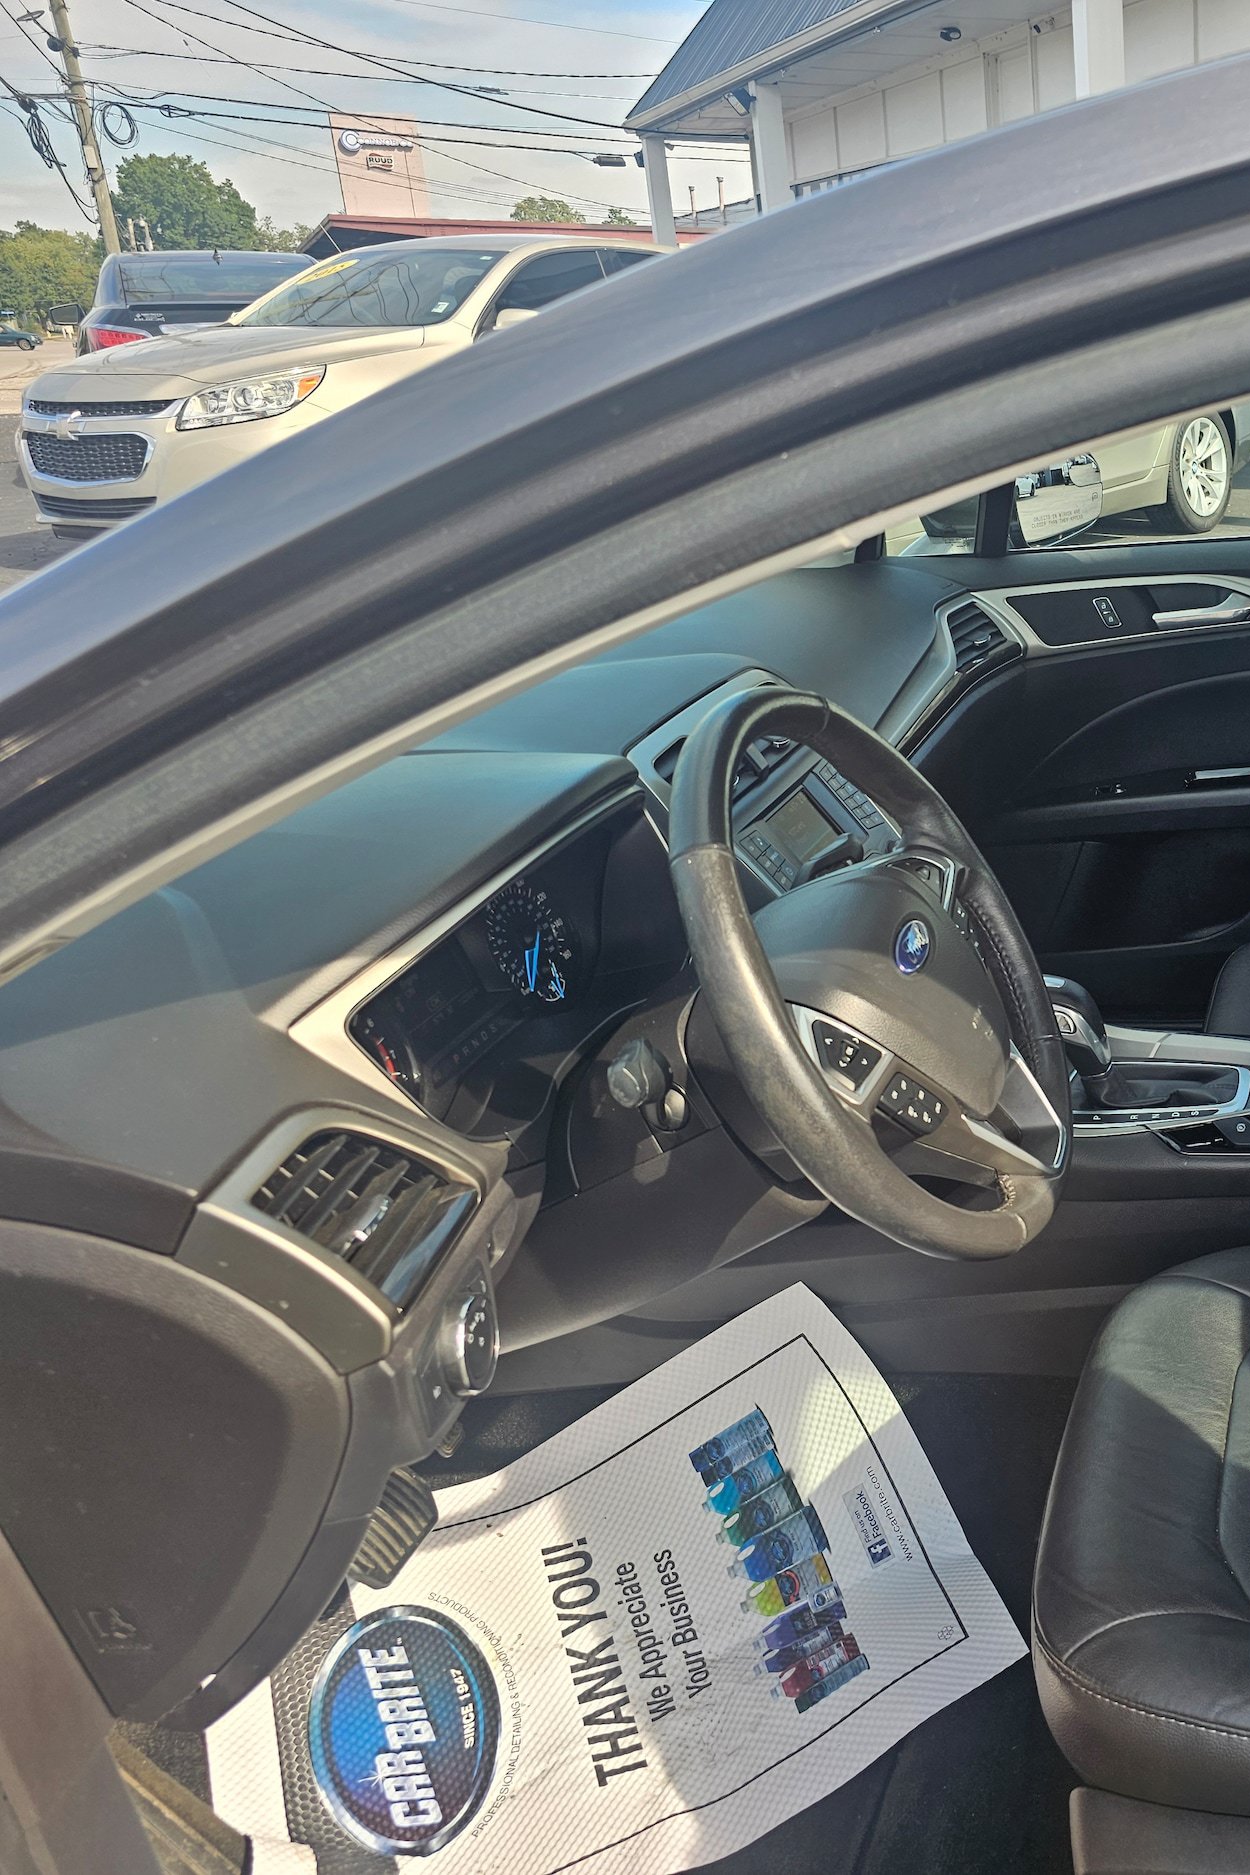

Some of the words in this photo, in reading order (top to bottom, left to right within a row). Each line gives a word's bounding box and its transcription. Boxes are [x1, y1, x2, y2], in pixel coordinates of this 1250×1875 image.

[368, 156, 393, 164] RUUD
[854, 1510, 863, 1520] on
[856, 1490, 882, 1539] Facebook
[858, 1519, 866, 1528] us
[862, 1528, 872, 1544] Find
[866, 1465, 913, 1562] www.carbrite.com
[427, 1591, 478, 1623] PRODUCTS
[541, 1537, 608, 1638] YOU!
[653, 1549, 699, 1647] Business
[615, 1561, 668, 1679] Appreciate
[474, 1619, 517, 1691] RECONDITIONING
[682, 1649, 712, 1699] Your
[358, 1646, 436, 1750] BRITE
[450, 1668, 471, 1701] 1947
[510, 1691, 519, 1699] &
[646, 1684, 676, 1722] We
[461, 1702, 476, 1750] SINCE
[509, 1700, 522, 1753] DETAILING
[565, 1635, 648, 1787] THANK
[375, 1750, 443, 1828] CAR
[471, 1753, 521, 1838] PROFESSIONAL
